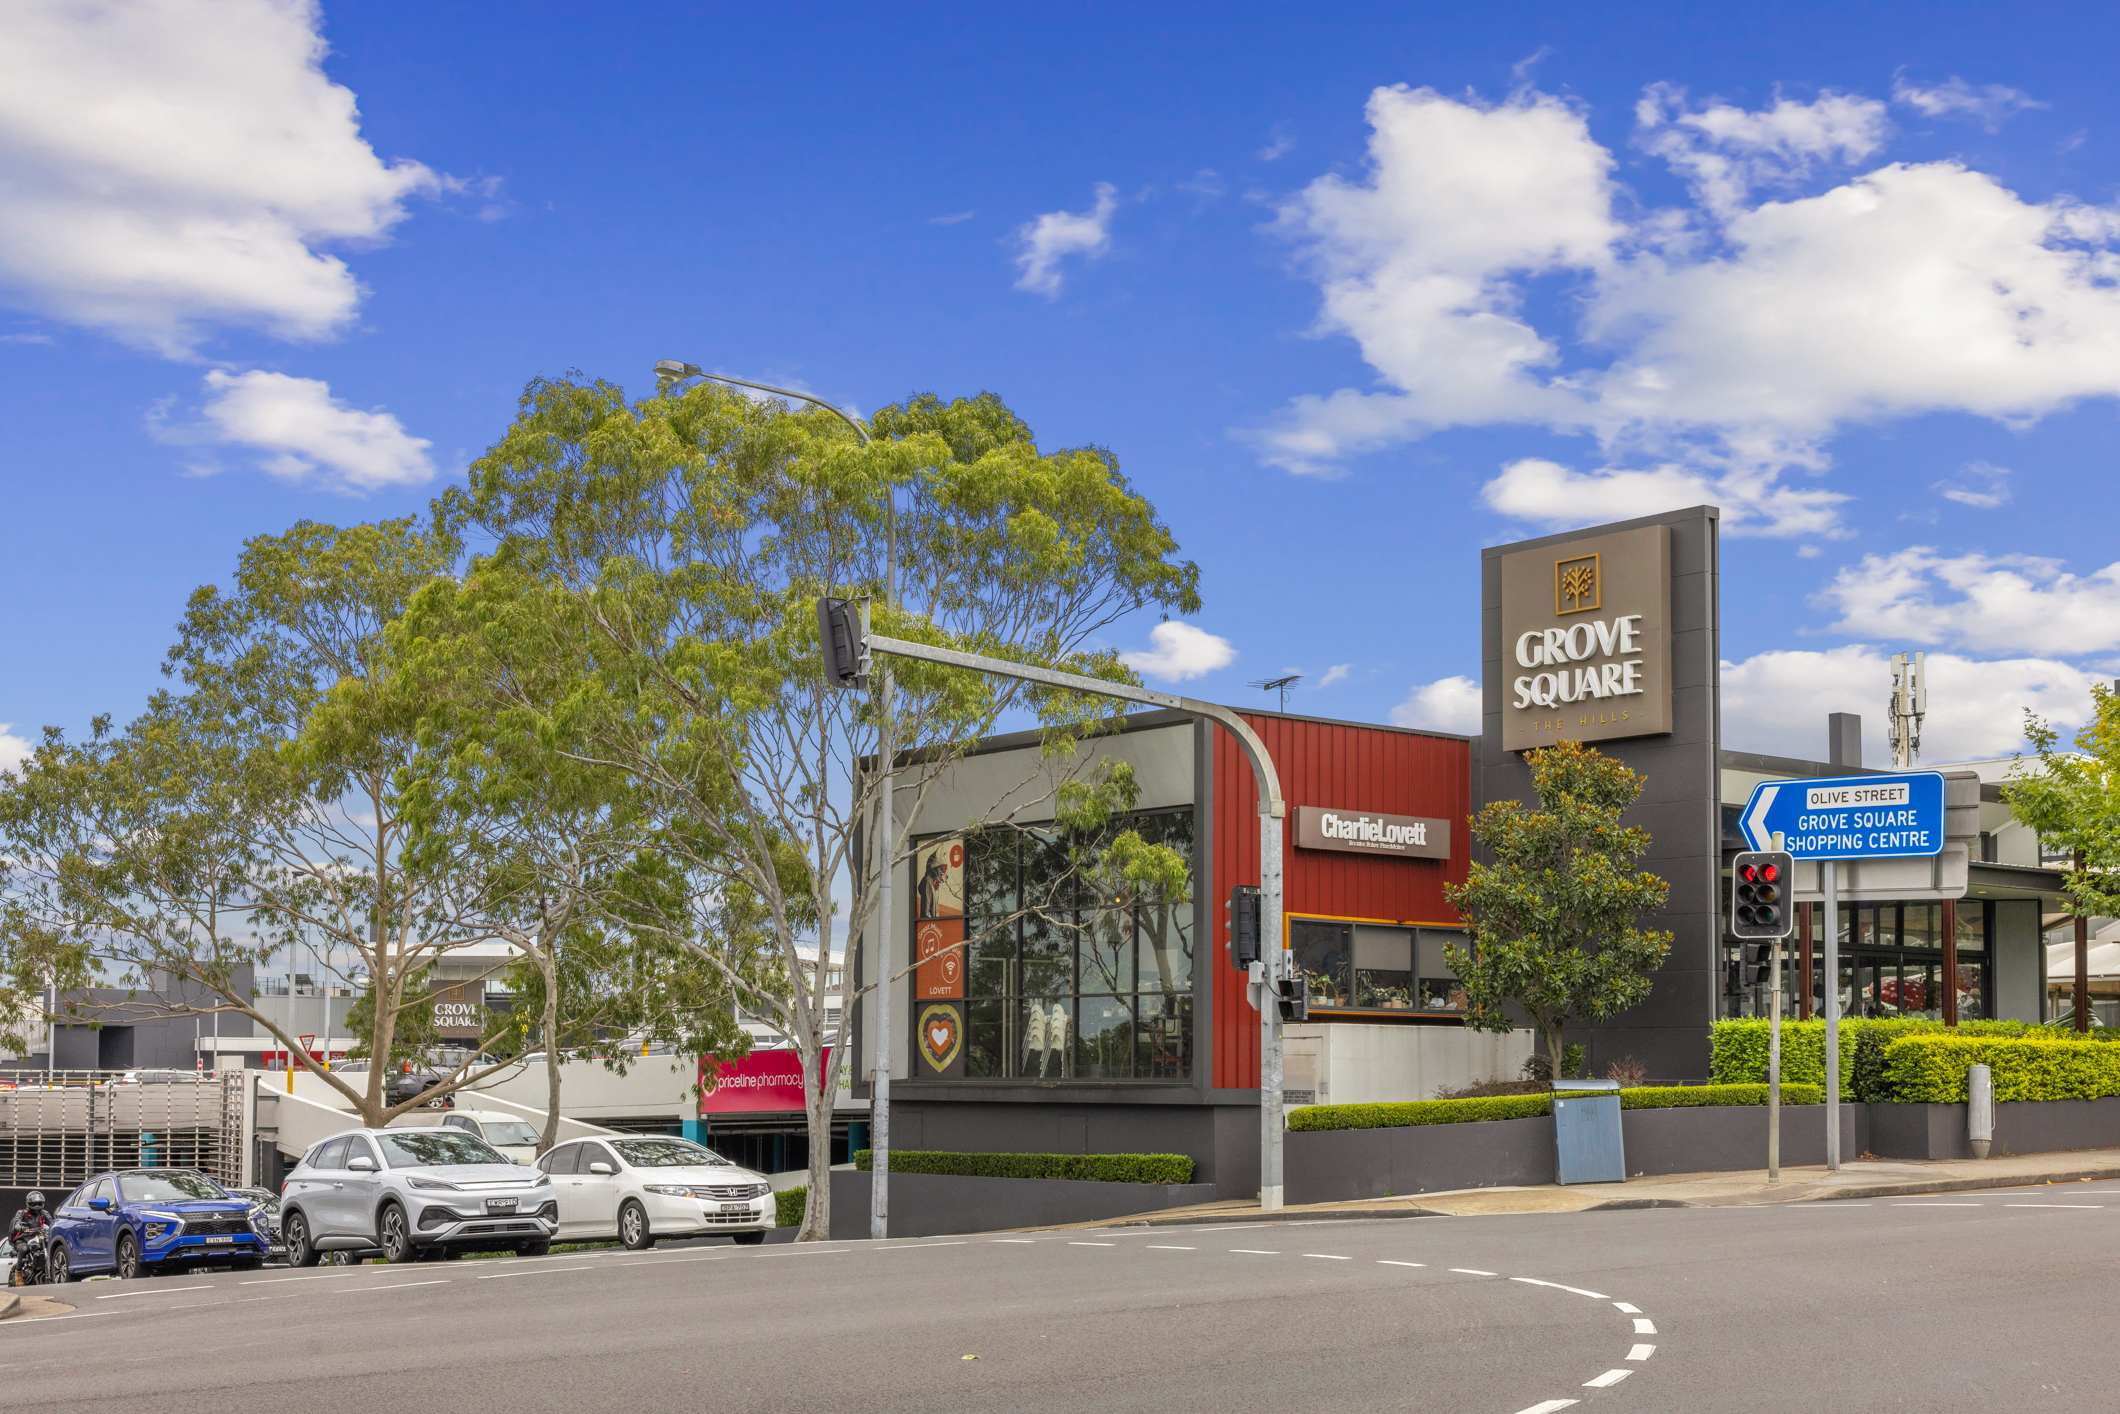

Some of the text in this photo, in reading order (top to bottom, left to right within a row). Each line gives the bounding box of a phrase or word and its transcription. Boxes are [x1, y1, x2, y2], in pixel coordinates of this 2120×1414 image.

[1516, 615, 1642, 668] GROVE
[1513, 660, 1643, 709] SQUARE
[1533, 710, 1629, 731] THE HILLS
[1811, 788, 1905, 804] OLIVE STREET
[1321, 813, 1427, 846] CharlieLovett
[1798, 810, 1917, 831] GROVE SQUARE
[1786, 831, 1930, 852] SHOPPING CENTRE
[929, 986, 952, 994] LOVETT
[718, 1072, 804, 1091] priceline pharmacy
